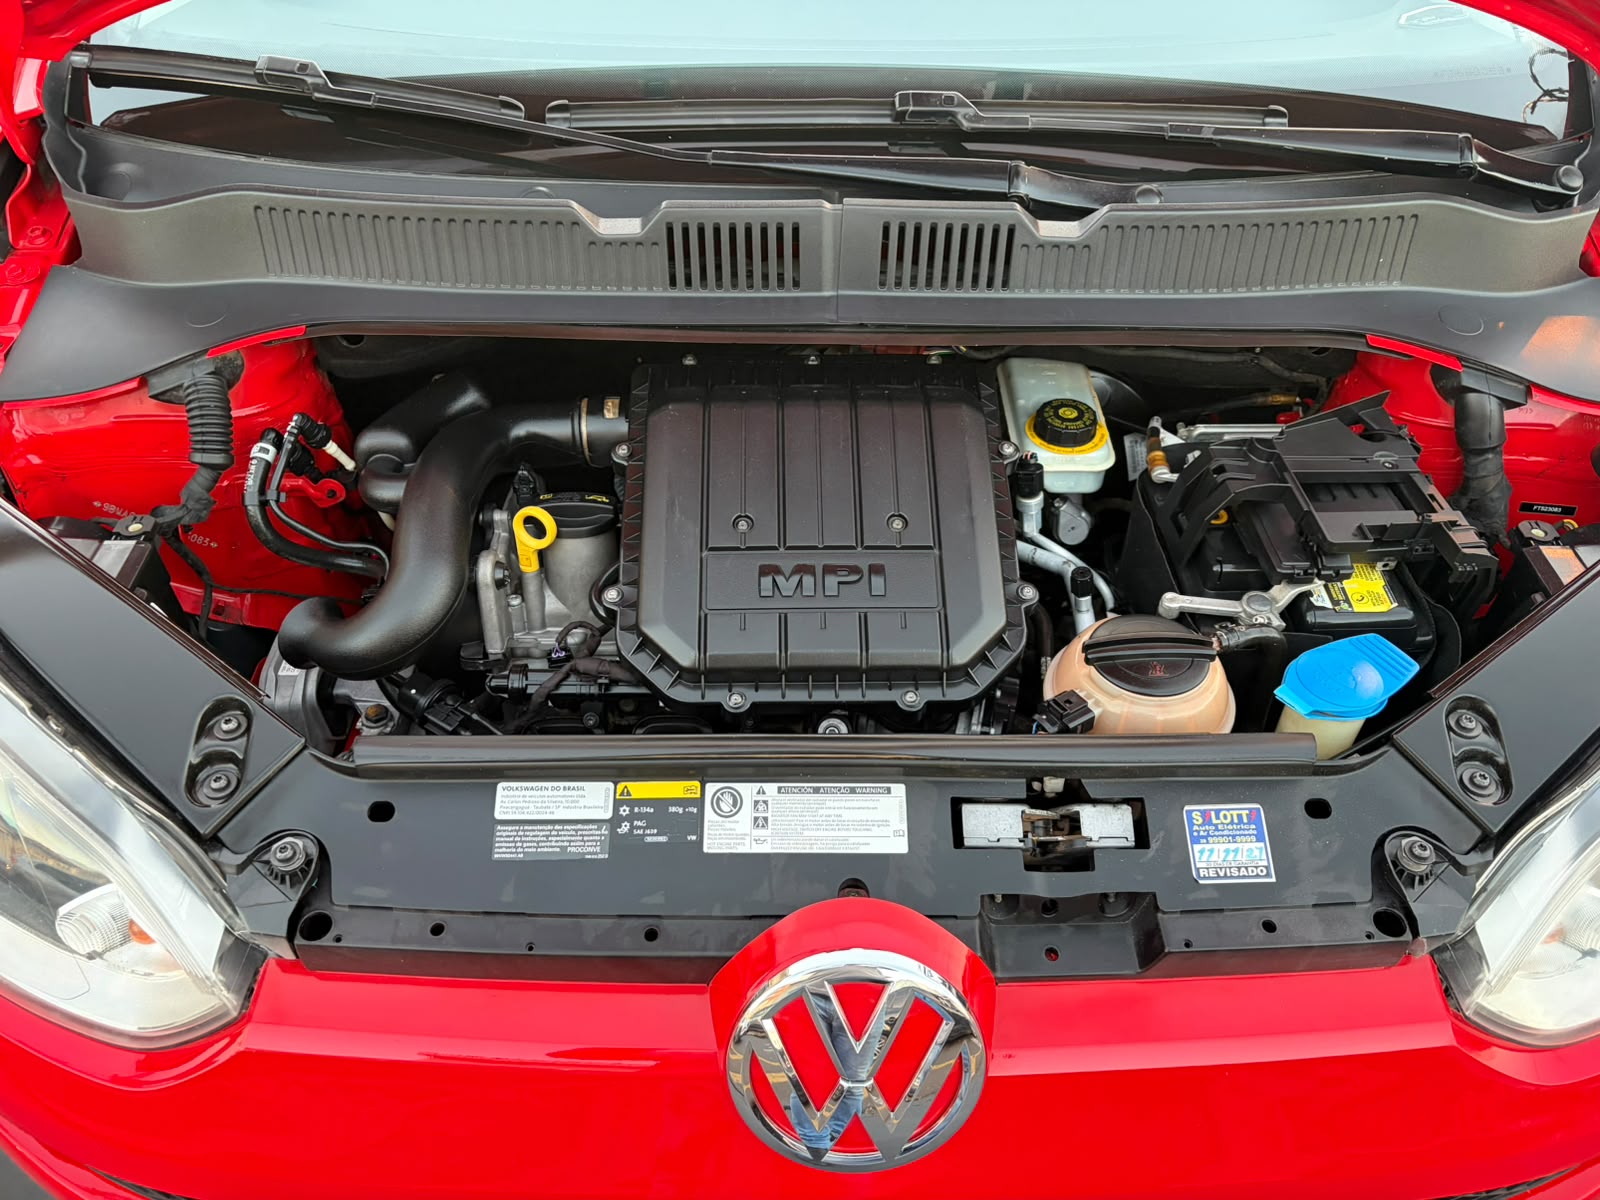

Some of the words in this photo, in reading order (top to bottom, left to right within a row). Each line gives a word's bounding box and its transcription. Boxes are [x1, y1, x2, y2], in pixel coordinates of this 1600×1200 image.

[758, 563, 887, 598] MPI
[780, 786, 813, 794] ATENCIÓN
[819, 786, 850, 794] ATENÇÃO
[668, 806, 684, 814] 380g
[1199, 867, 1267, 878] REVISADO
